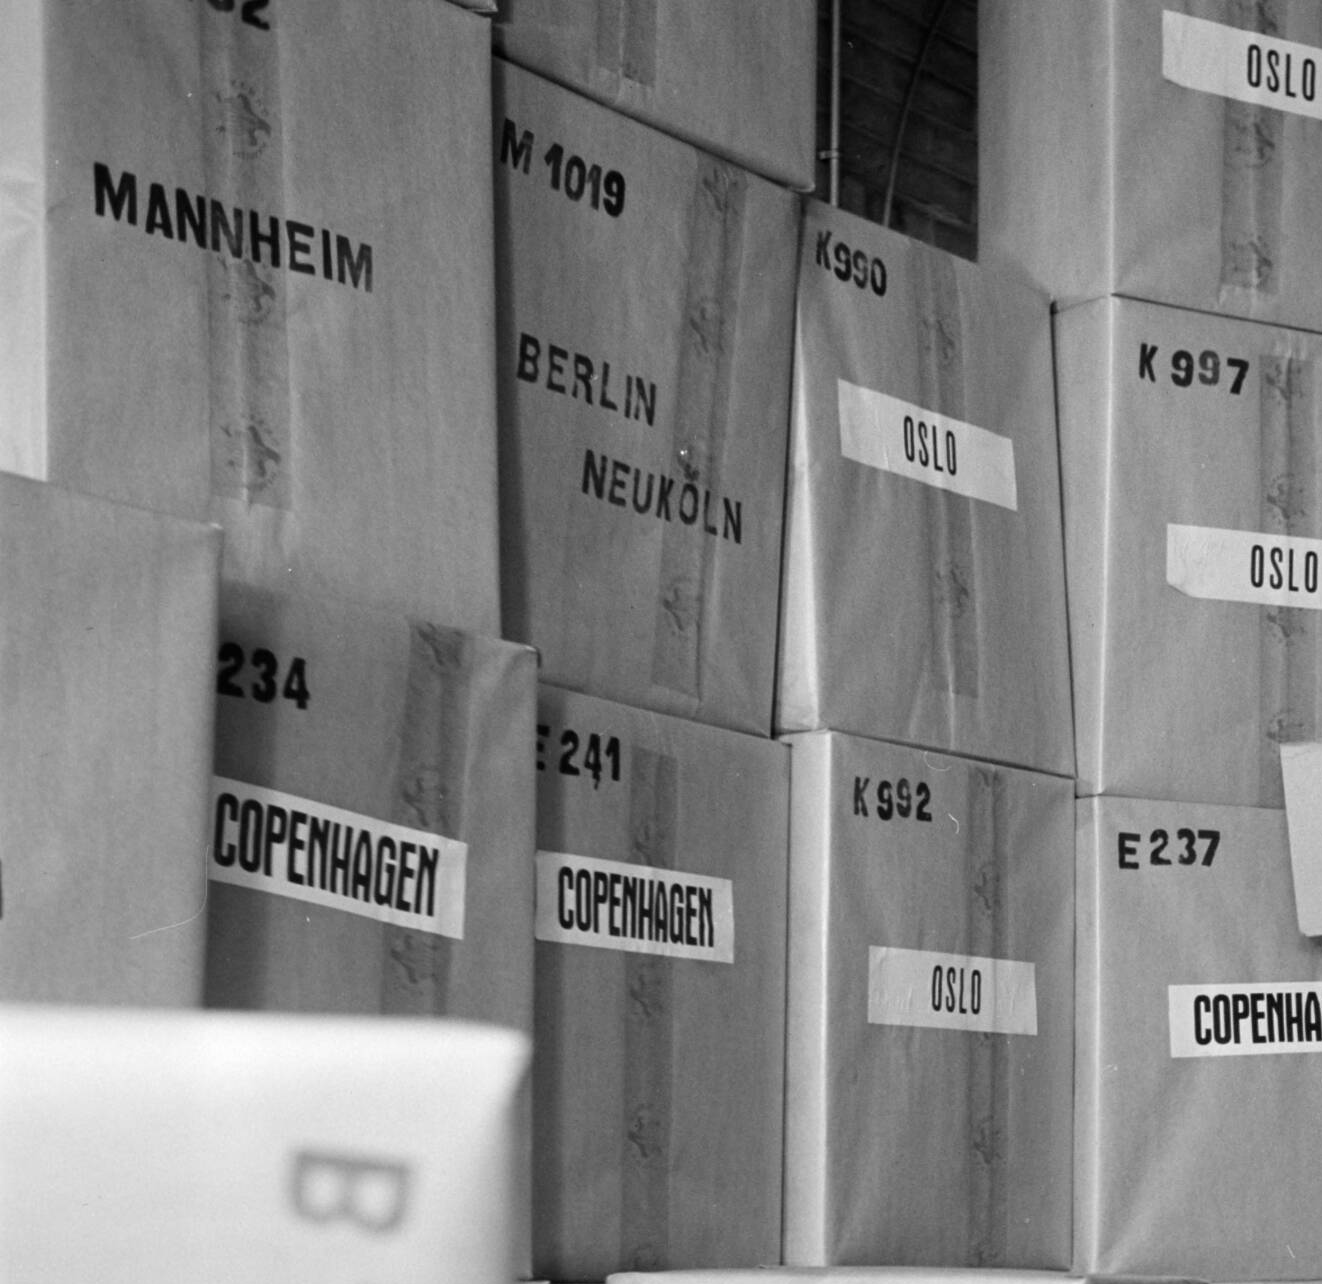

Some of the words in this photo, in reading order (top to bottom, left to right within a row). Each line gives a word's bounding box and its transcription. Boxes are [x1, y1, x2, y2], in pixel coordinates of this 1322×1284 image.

[1246, 43, 1317, 102] OSLO
[94, 161, 374, 293] MANNHEIM
[516, 332, 657, 427] BERLIN
[903, 414, 958, 477] OSLO
[1249, 544, 1320, 594] OSLO
[217, 642, 311, 710] 234
[213, 792, 440, 917] COPENHAGEN
[557, 866, 715, 949] COPENHAGEN
[931, 964, 982, 1015] OSLO
